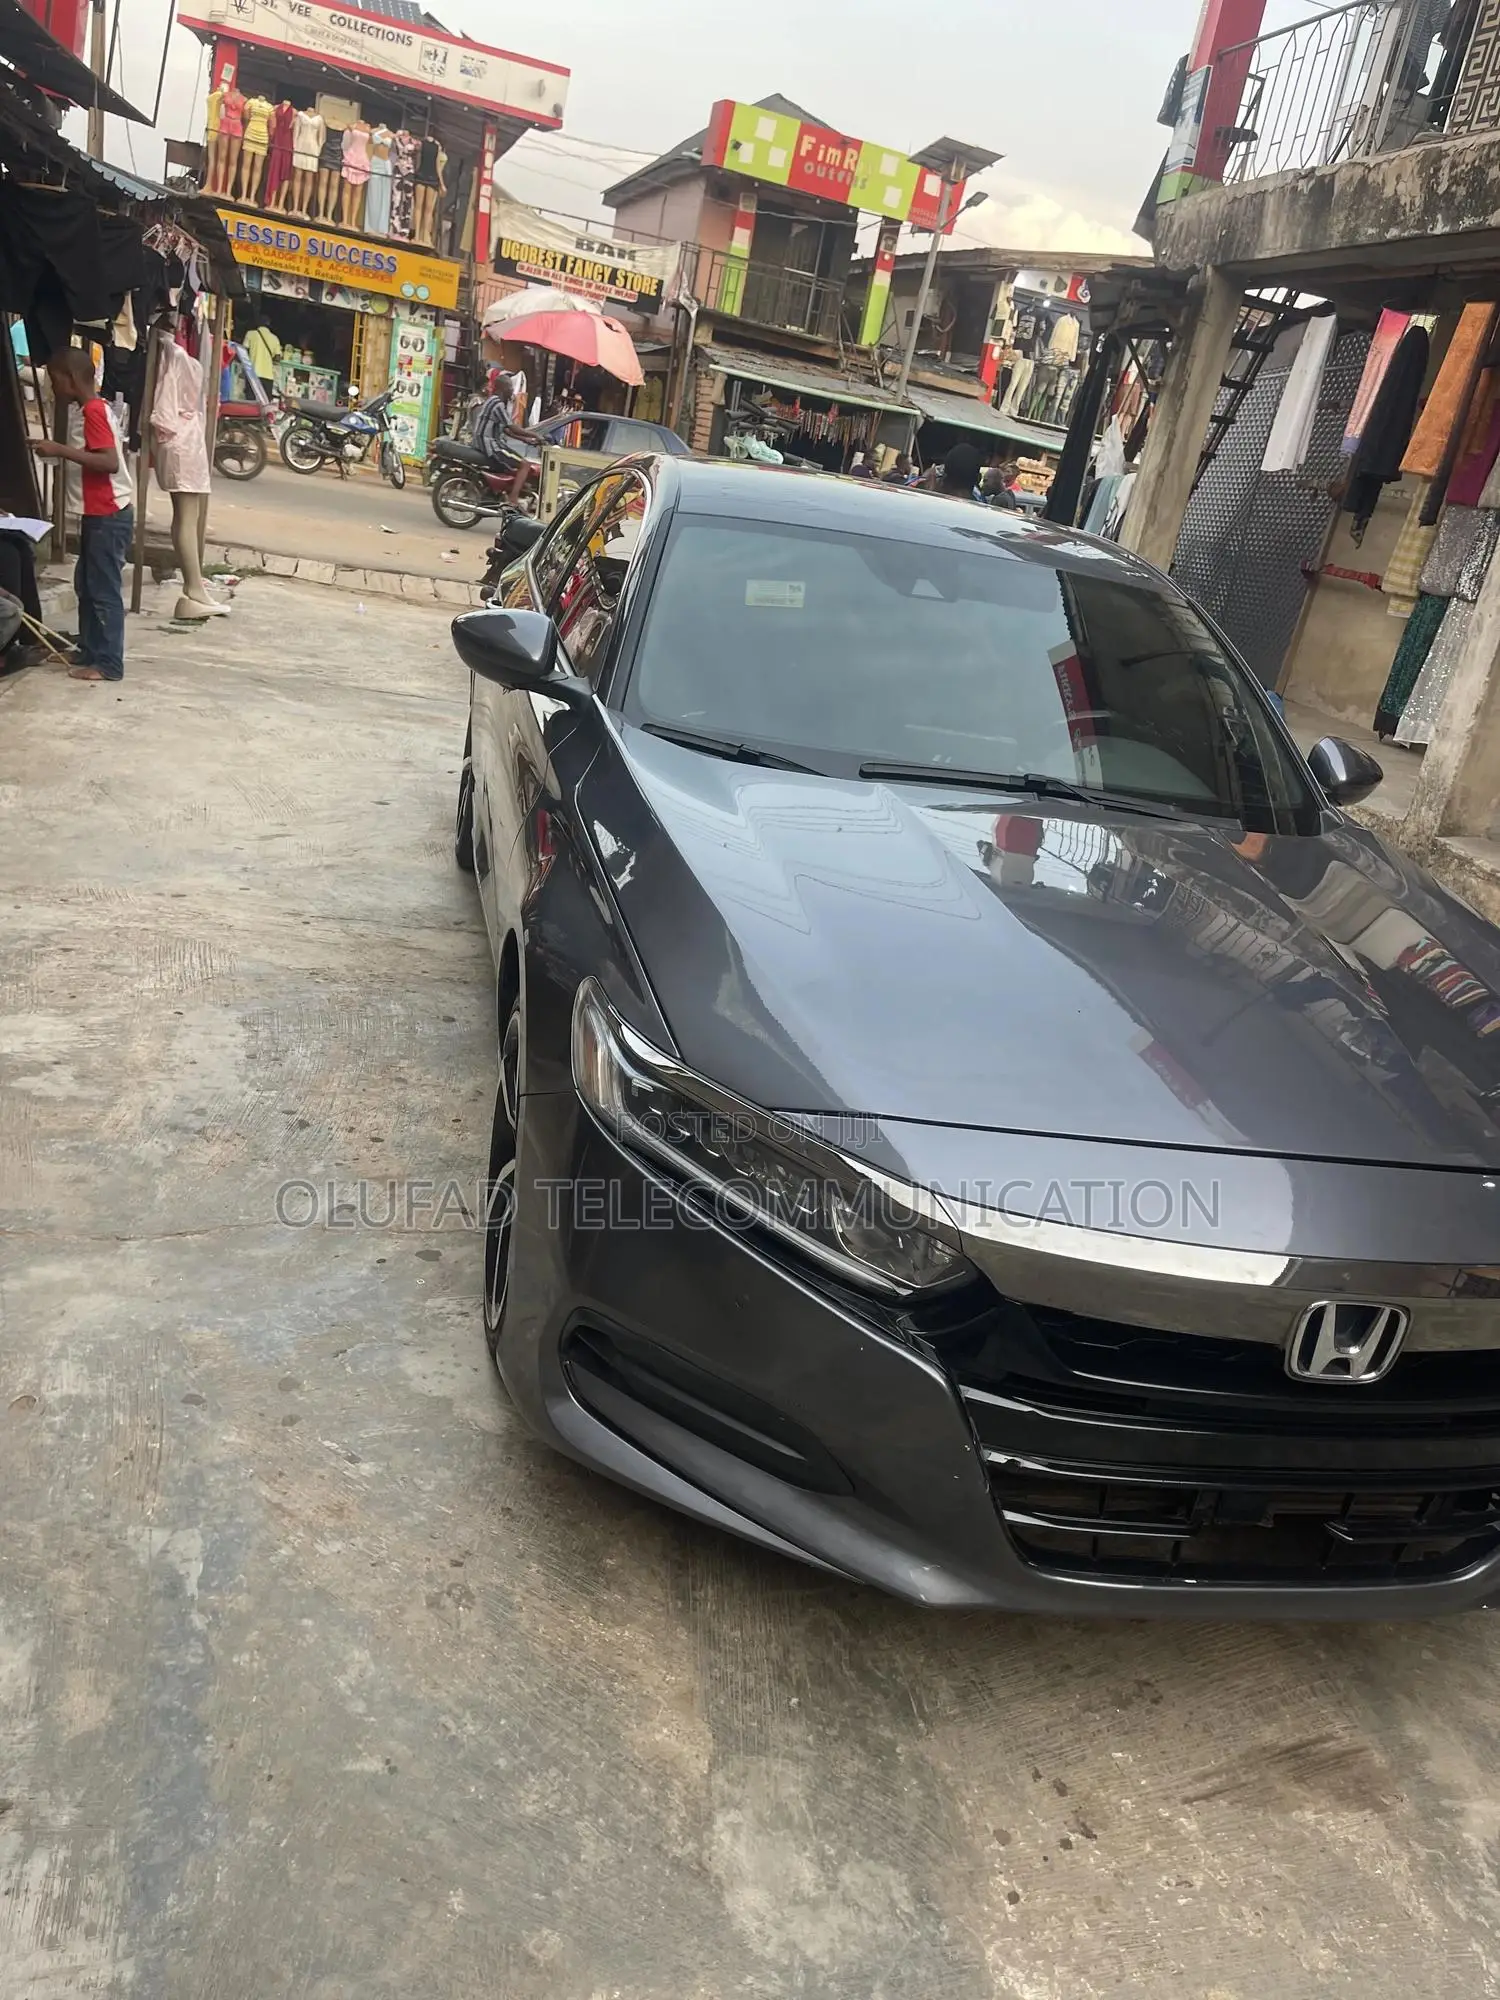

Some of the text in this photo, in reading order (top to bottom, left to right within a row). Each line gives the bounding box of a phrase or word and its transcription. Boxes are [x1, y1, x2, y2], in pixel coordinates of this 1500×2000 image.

[288, 1, 311, 17] VEE
[329, 14, 413, 46] COLLECTIONS
[223, 219, 397, 273] LESSED SUCCESS
[500, 239, 566, 272] UGOBEST
[565, 255, 613, 284] FANCY
[615, 268, 659, 296] STORE
